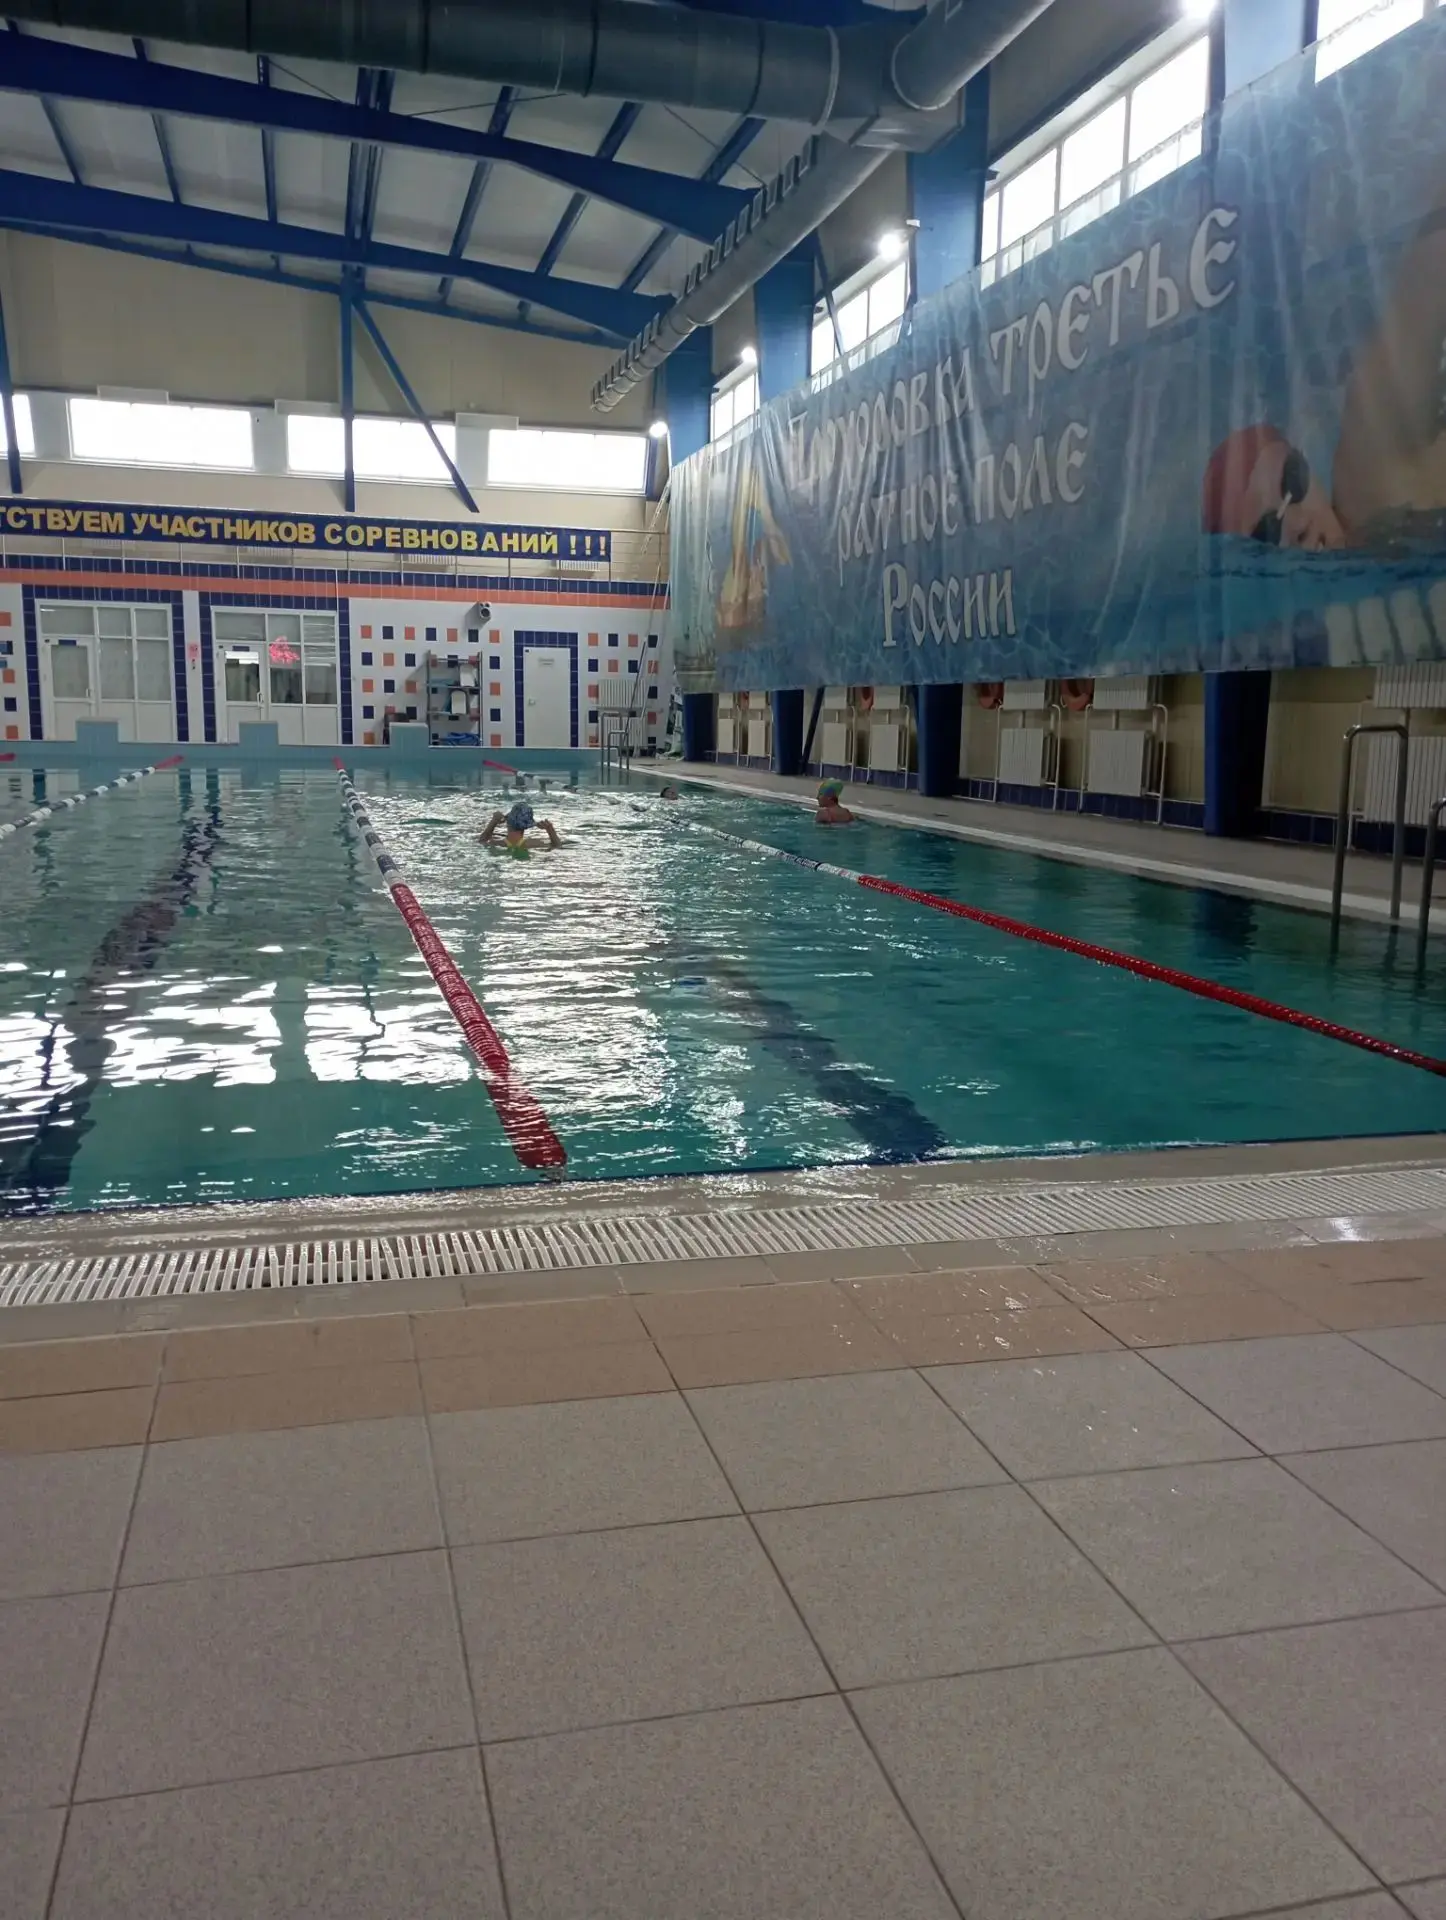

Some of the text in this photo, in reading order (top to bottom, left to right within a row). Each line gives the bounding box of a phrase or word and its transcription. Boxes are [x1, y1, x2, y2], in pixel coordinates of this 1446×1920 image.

[131, 513, 317, 544] УЧАСТНИКОВ
[324, 523, 558, 555] СОРЕВНОВАНИЙ
[882, 562, 1017, 648] России
